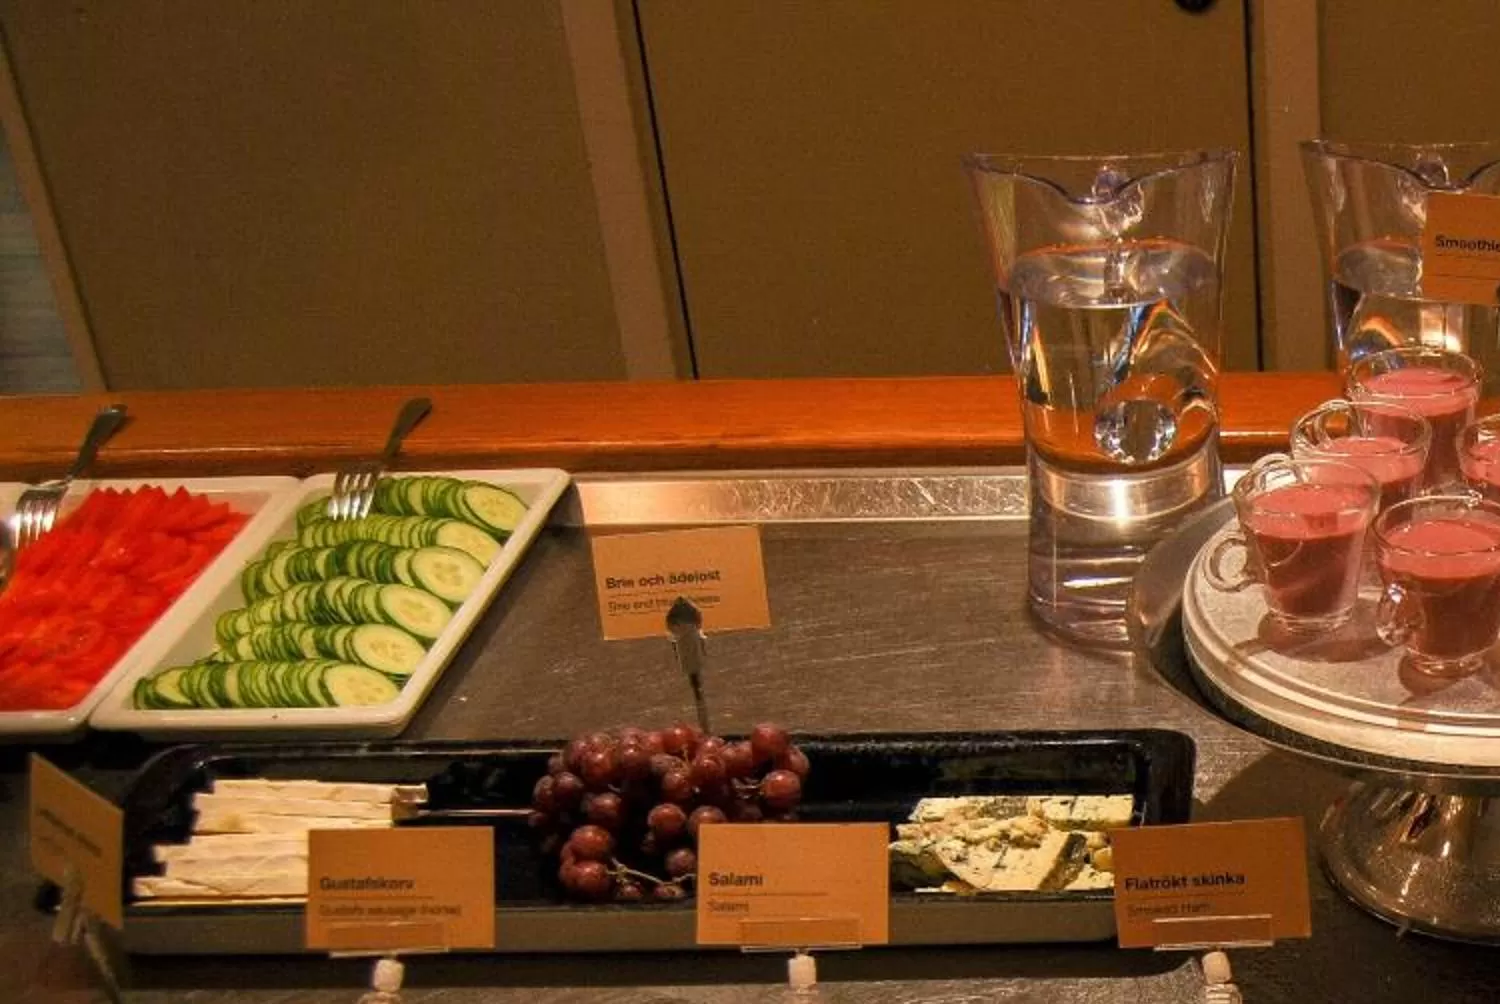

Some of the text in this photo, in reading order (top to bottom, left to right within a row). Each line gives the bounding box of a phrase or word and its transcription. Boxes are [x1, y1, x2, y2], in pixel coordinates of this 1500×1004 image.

[605, 577, 635, 590] Brie
[639, 574, 665, 587] och
[708, 871, 764, 887] Salami
[1192, 872, 1247, 887] skinka
